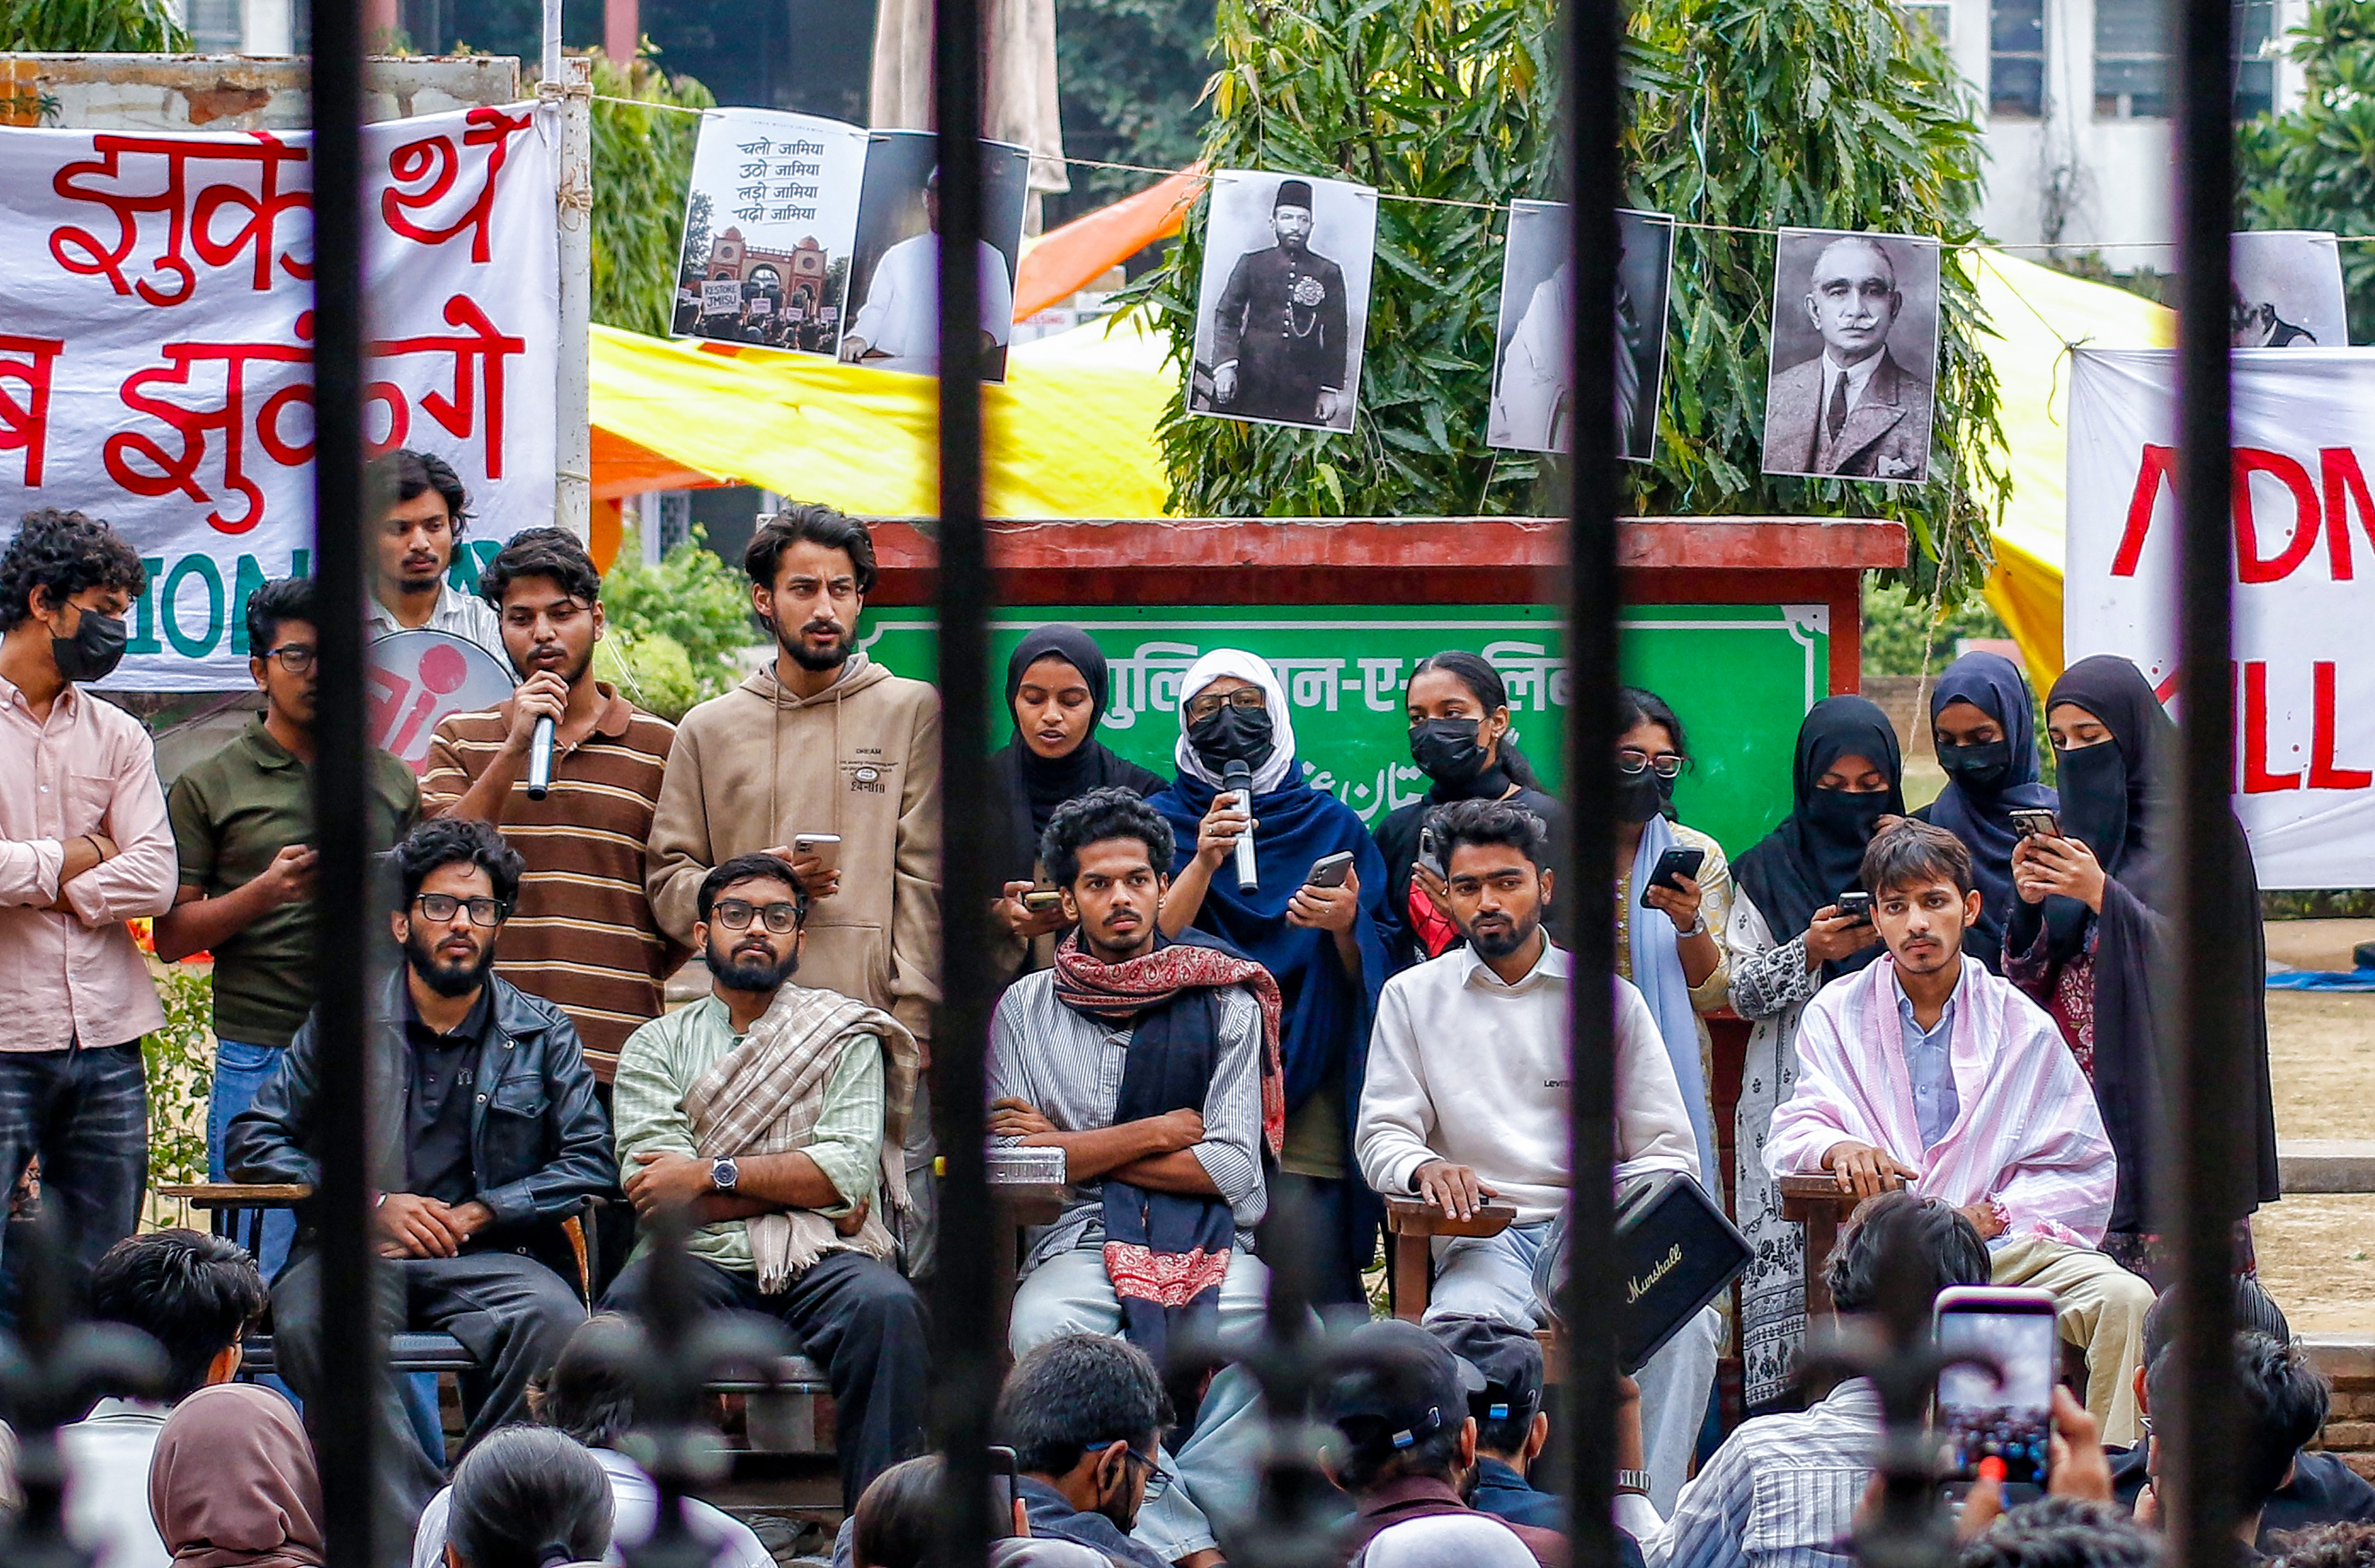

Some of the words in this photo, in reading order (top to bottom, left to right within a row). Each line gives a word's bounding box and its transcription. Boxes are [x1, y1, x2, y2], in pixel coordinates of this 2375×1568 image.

[735, 136, 776, 155] चलो
[778, 139, 825, 156] जामिया
[739, 159, 772, 179] उठो
[775, 161, 821, 176] जामिया
[773, 182, 819, 198] जामिया
[771, 204, 817, 220] जामिया
[707, 295, 736, 307] JMISU
[1626, 1243, 1682, 1304] Marshall
